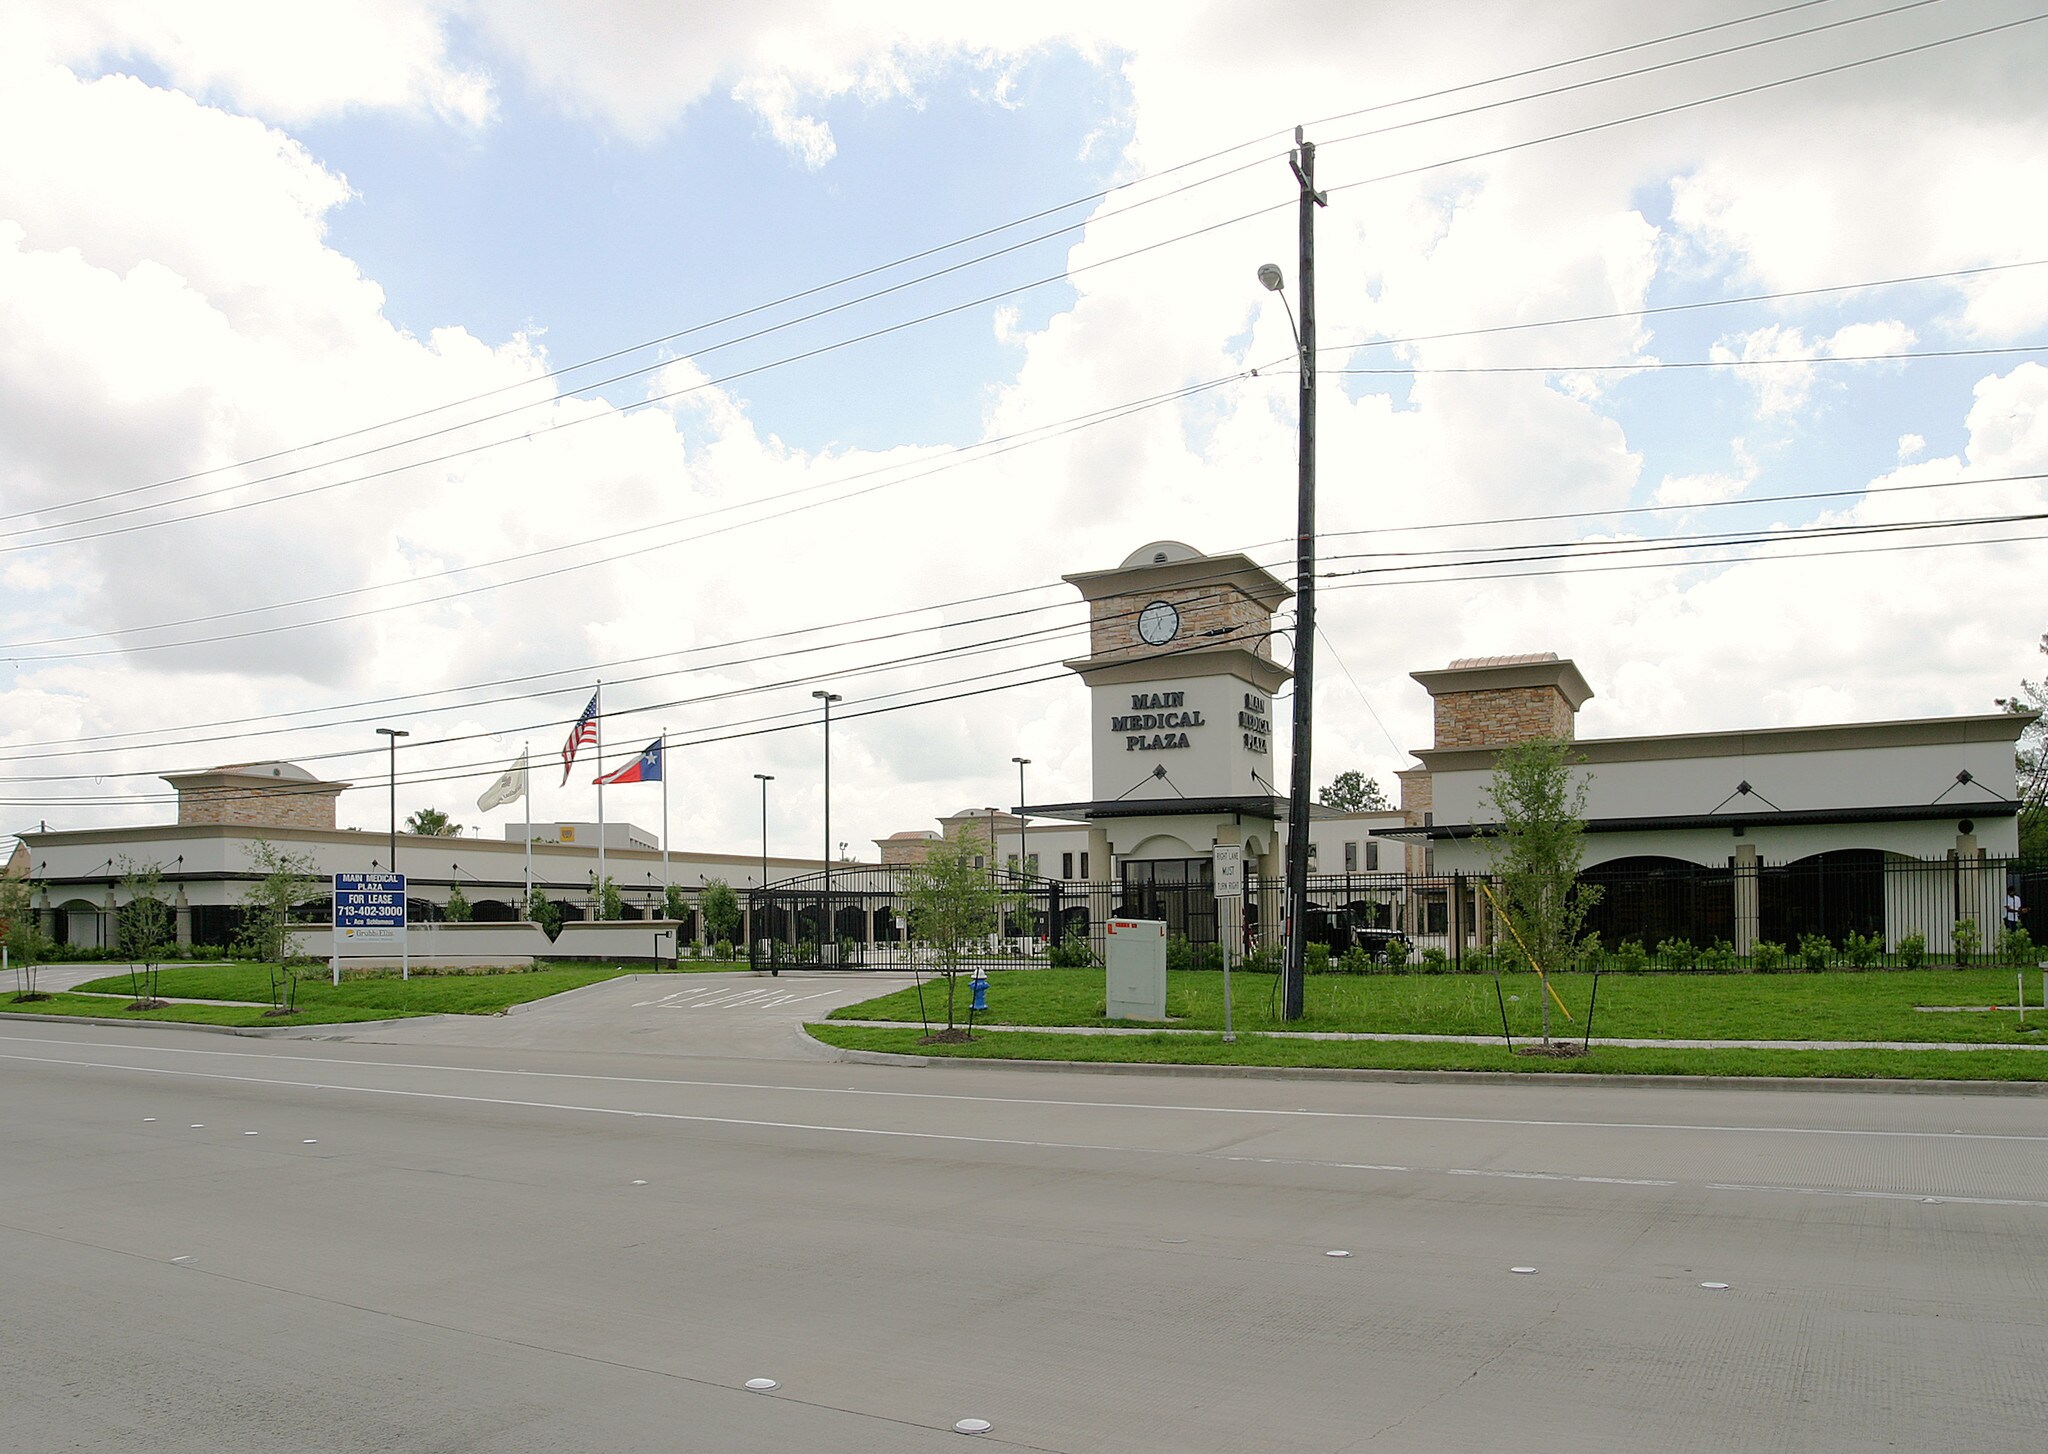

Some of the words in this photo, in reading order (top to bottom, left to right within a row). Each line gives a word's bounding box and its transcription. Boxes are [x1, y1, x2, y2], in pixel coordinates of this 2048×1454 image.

[1131, 691, 1185, 710] MAIN
[1111, 711, 1206, 732] MEDICAL
[1126, 732, 1190, 752] PLAZA
[1222, 866, 1234, 875] MUST
[342, 874, 363, 882] MAIN
[366, 874, 398, 882] MEDICAL
[357, 883, 383, 891] PLAZA
[348, 894, 365, 904] FOR
[368, 894, 393, 904] LEASE
[337, 905, 403, 916] 713-402-3000
